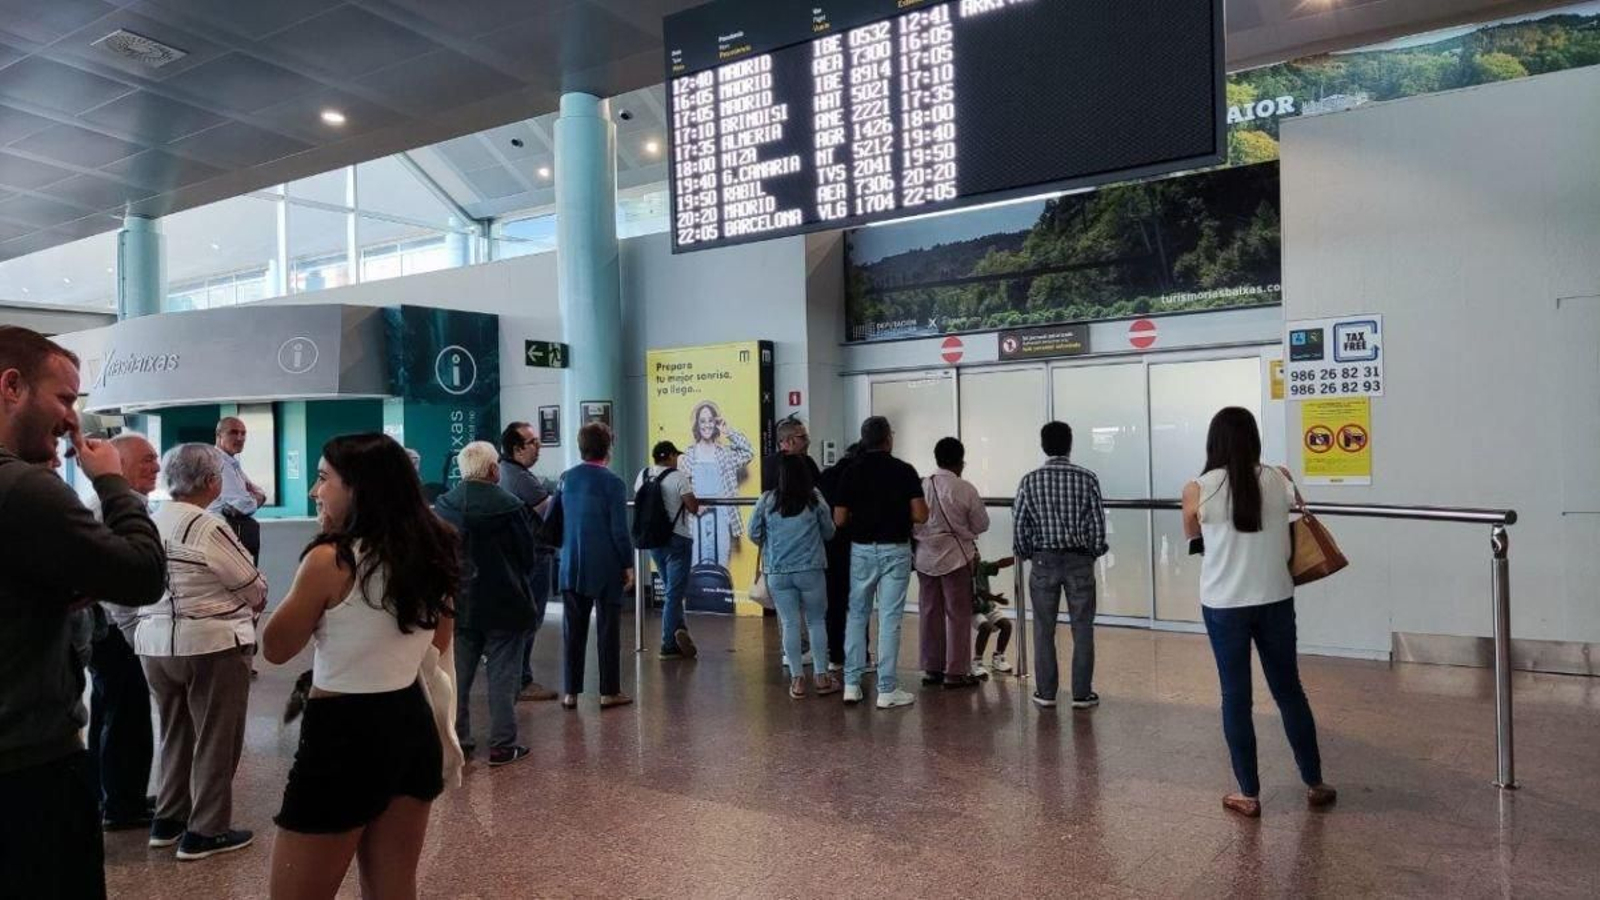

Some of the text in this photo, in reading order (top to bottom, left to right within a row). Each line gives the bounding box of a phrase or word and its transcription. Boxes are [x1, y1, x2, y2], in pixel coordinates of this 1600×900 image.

[672, 69, 714, 95] 12:40
[718, 54, 772, 83] MADRID
[813, 34, 842, 57] IBE
[850, 20, 890, 47] 0532
[899, 3, 950, 34] 12:41
[673, 22, 953, 112] 16:05 MADRID AEA 7300 16:05
[673, 43, 953, 128] 17:05 MADRID IBE 8914 17:05
[674, 122, 715, 145] 17:10
[851, 79, 889, 103] 5021
[900, 63, 954, 91] 17:10
[1227, 95, 1295, 124] AIOR
[675, 138, 716, 162] 17:35
[721, 123, 783, 150] ALMERIA
[852, 98, 890, 122] 2221
[901, 82, 954, 111] 17:35
[675, 156, 716, 178] 18:00
[722, 147, 757, 168] NIZA
[853, 116, 893, 140] 1426
[901, 102, 955, 130] 18:00
[676, 123, 955, 195] 19:40 G.CANARIA NT 5212 19:40
[677, 142, 956, 211] 19:50 RABIL TVS 2041 19:50
[677, 162, 956, 228] 20:20 MADRID AEA 7306 20:20
[678, 181, 957, 245] 22:05 BARCELONA VLG 1704 22:05
[656, 362, 692, 372] Prepara
[1344, 341, 1367, 351] FREE
[1345, 332, 1365, 341] TAX
[656, 375, 665, 384] tu
[667, 374, 694, 384] mejor
[657, 387, 668, 397] ya
[1290, 366, 1379, 381] 986 26 82 31
[1290, 380, 1380, 395] 986 26 82 93
